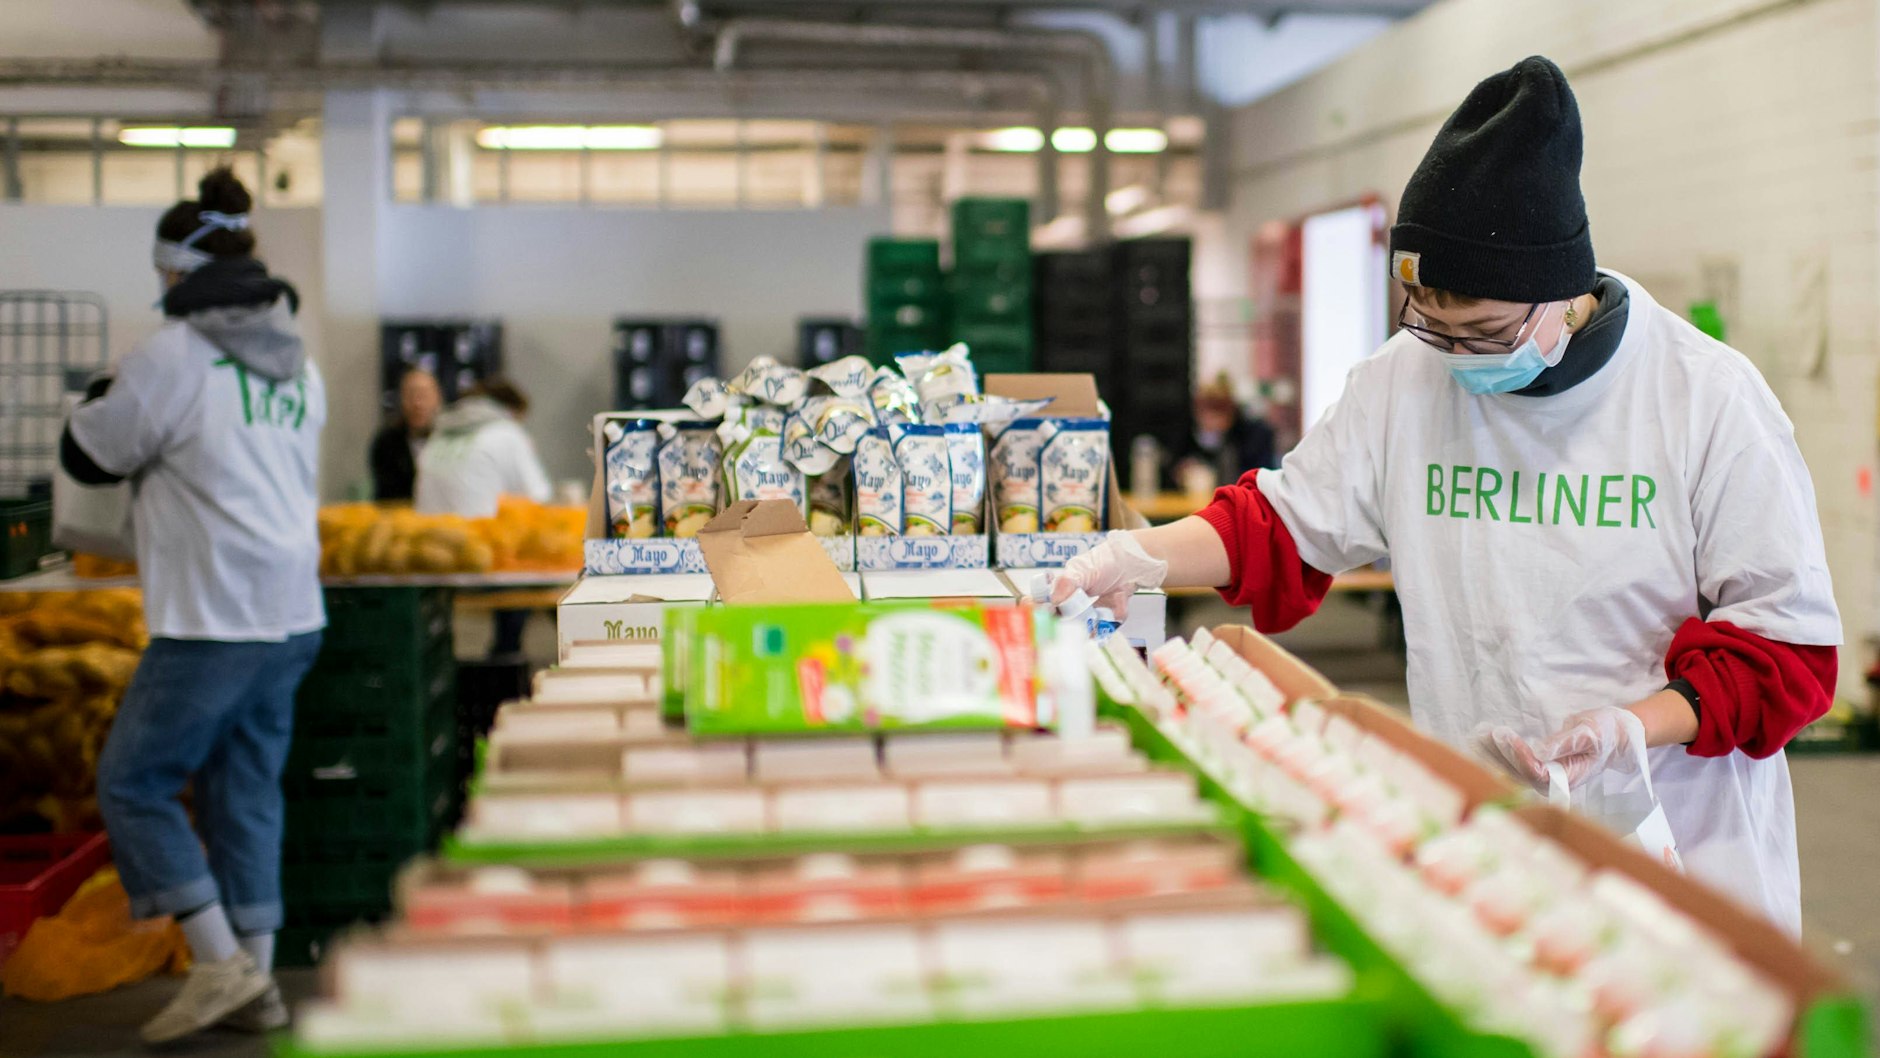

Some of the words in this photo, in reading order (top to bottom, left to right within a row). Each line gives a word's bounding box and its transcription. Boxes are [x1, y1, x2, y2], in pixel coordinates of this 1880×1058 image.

[679, 463, 708, 481] Mayo
[755, 469, 790, 488] Mayo
[857, 470, 885, 492] Mayo
[901, 469, 931, 492] Mayo
[952, 472, 973, 489] ayo
[1005, 463, 1035, 482] Mayo
[1059, 464, 1089, 483] Mayo
[1426, 463, 1657, 529] BERLINER
[630, 545, 668, 568] Mayo
[901, 538, 939, 564] Mayo
[1041, 538, 1079, 564] Mayo
